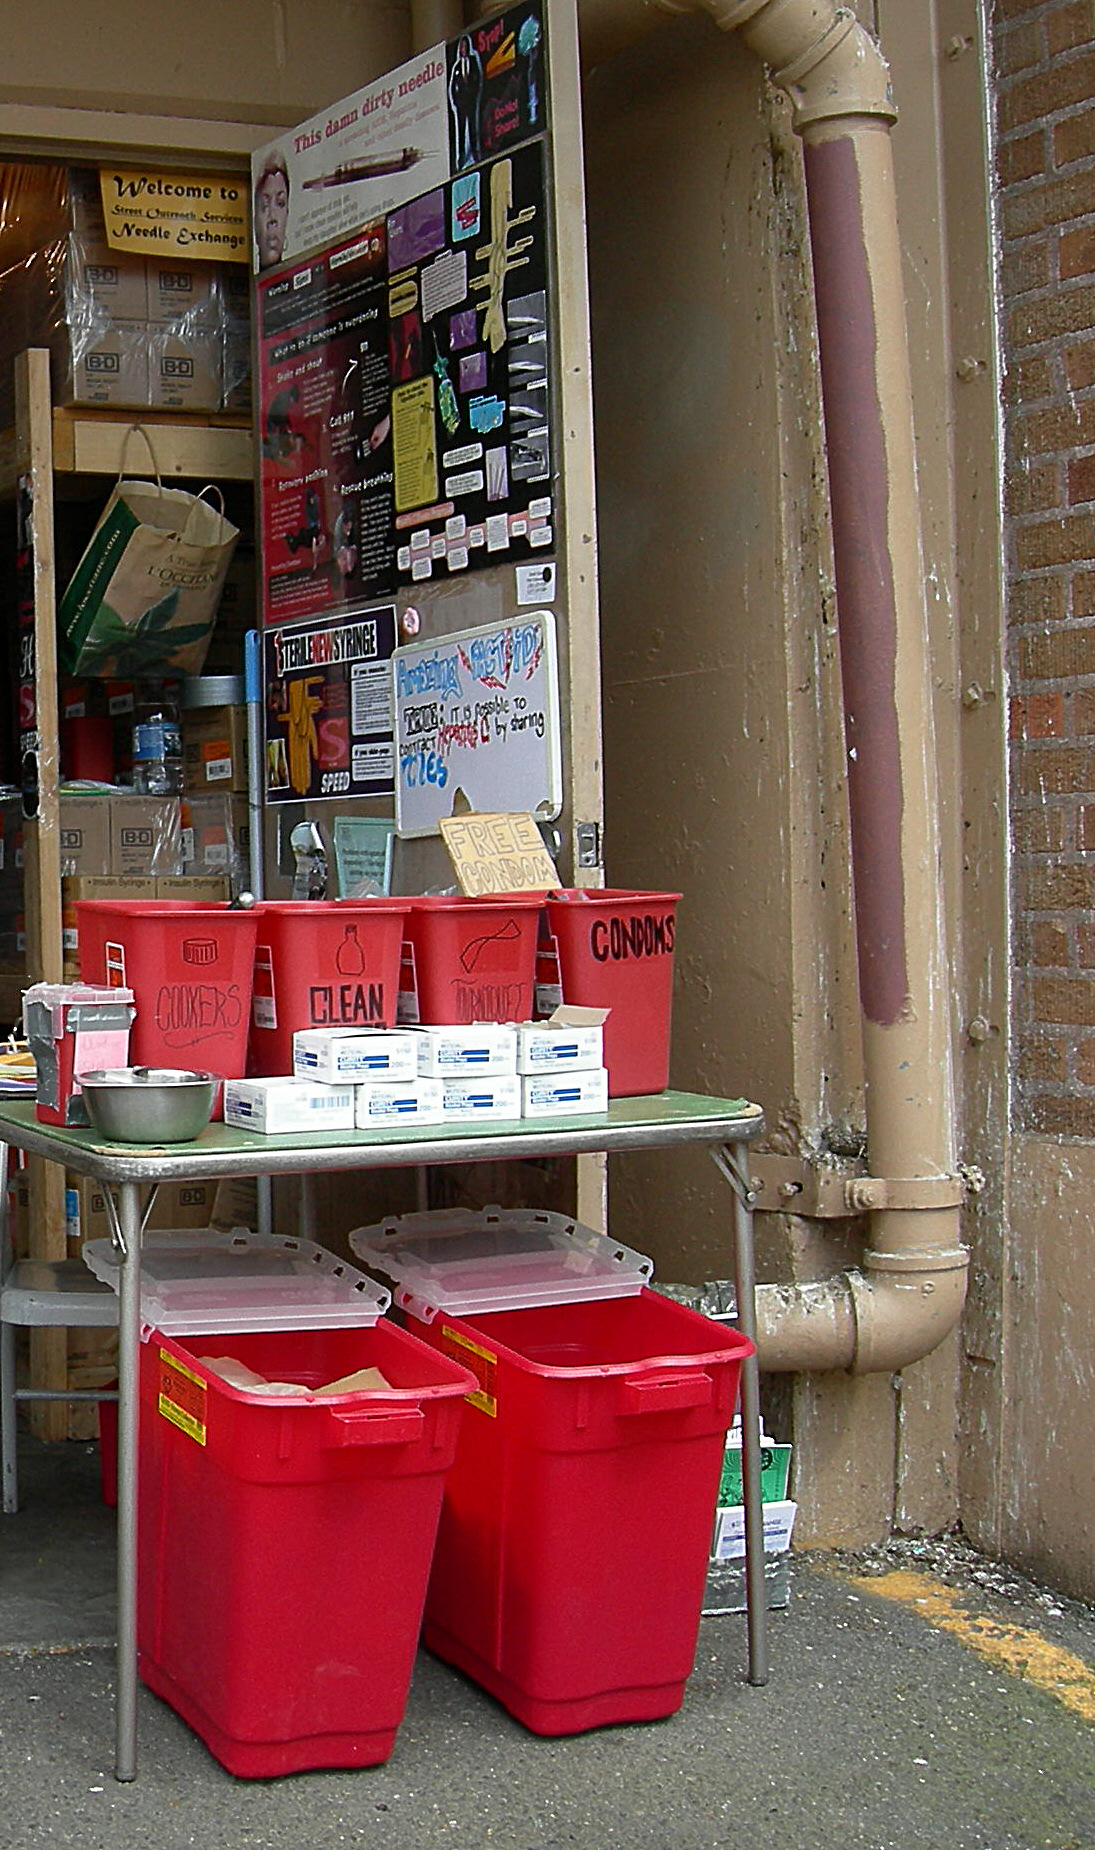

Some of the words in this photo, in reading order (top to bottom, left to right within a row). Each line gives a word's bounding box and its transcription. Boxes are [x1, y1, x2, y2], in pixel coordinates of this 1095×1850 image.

[294, 129, 322, 154] This
[325, 108, 359, 139] damn
[362, 88, 395, 117] dirty
[397, 61, 444, 98] needle
[113, 175, 212, 199] Welcome
[220, 187, 239, 201] to
[111, 204, 144, 215] Street
[146, 208, 196, 220] Outreach
[200, 212, 244, 224] Services
[112, 222, 171, 239] Needle
[176, 228, 246, 249] Exchange
[320, 771, 350, 794] SPEED
[443, 815, 546, 860] FREE
[460, 855, 557, 895] CONDOM
[591, 914, 675, 962] CONDOMS
[155, 984, 242, 1032] COOKERS
[310, 983, 384, 1023] CLEAN
